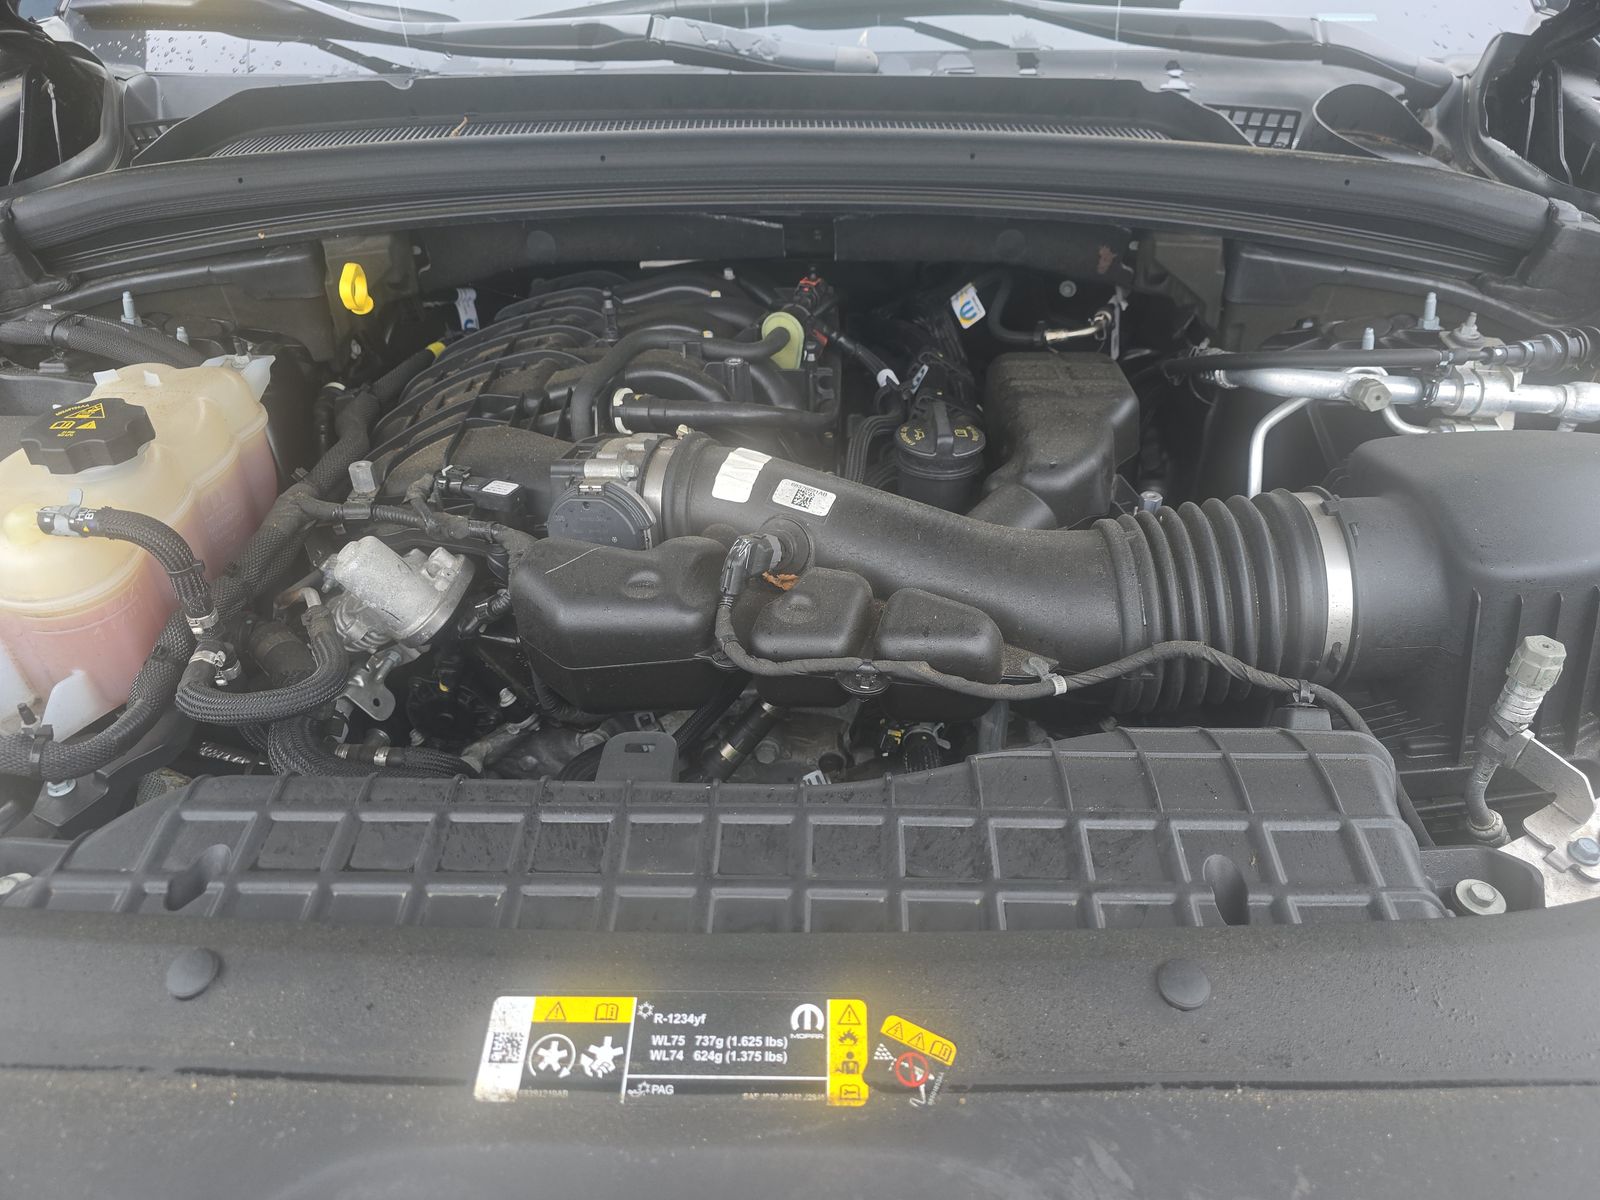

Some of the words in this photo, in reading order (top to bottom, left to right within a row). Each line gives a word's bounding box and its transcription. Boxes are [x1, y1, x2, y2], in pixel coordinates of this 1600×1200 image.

[653, 1013, 706, 1026] R-1234yf
[651, 1035, 686, 1046] WL75
[694, 1035, 724, 1049] 737g
[726, 1036, 763, 1049] (1.625
[764, 1036, 788, 1049] lbs)
[649, 1050, 684, 1061] WL74
[692, 1051, 723, 1064] 624g
[725, 1051, 762, 1064] (1.375
[764, 1051, 788, 1064] lbs)
[651, 1085, 674, 1095] PAG
